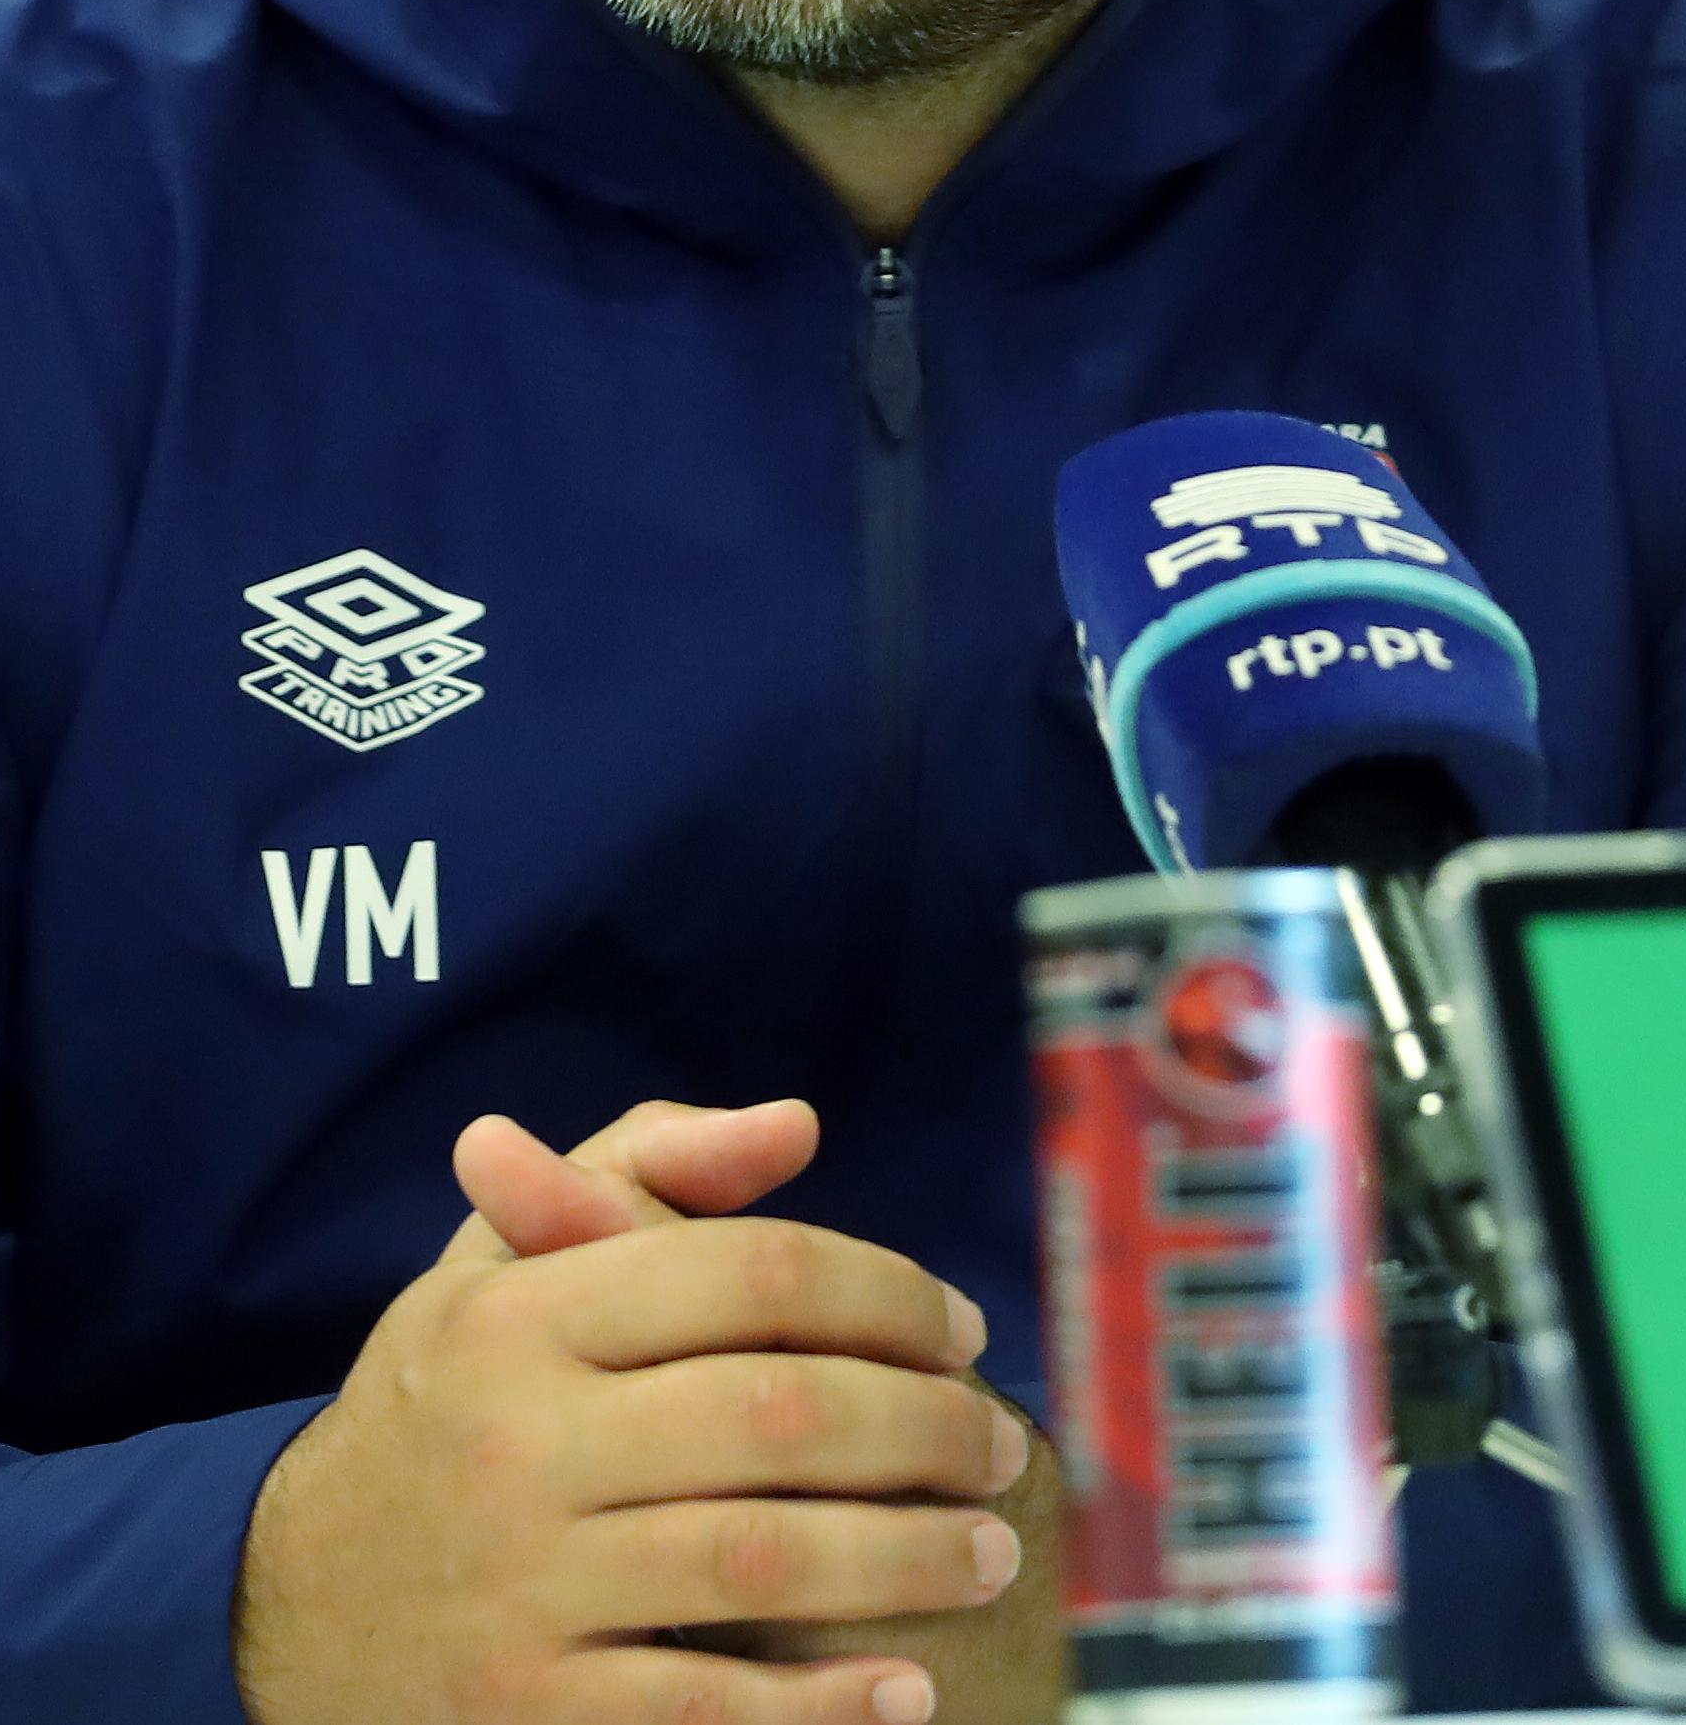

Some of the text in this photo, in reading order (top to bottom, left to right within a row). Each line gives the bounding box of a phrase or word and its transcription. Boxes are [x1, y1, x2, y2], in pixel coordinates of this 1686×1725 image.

[1145, 511, 1449, 589] RTP
[1226, 625, 1454, 692] rtp.pt
[269, 669, 464, 739] TRAINING
[260, 839, 441, 990] VM
